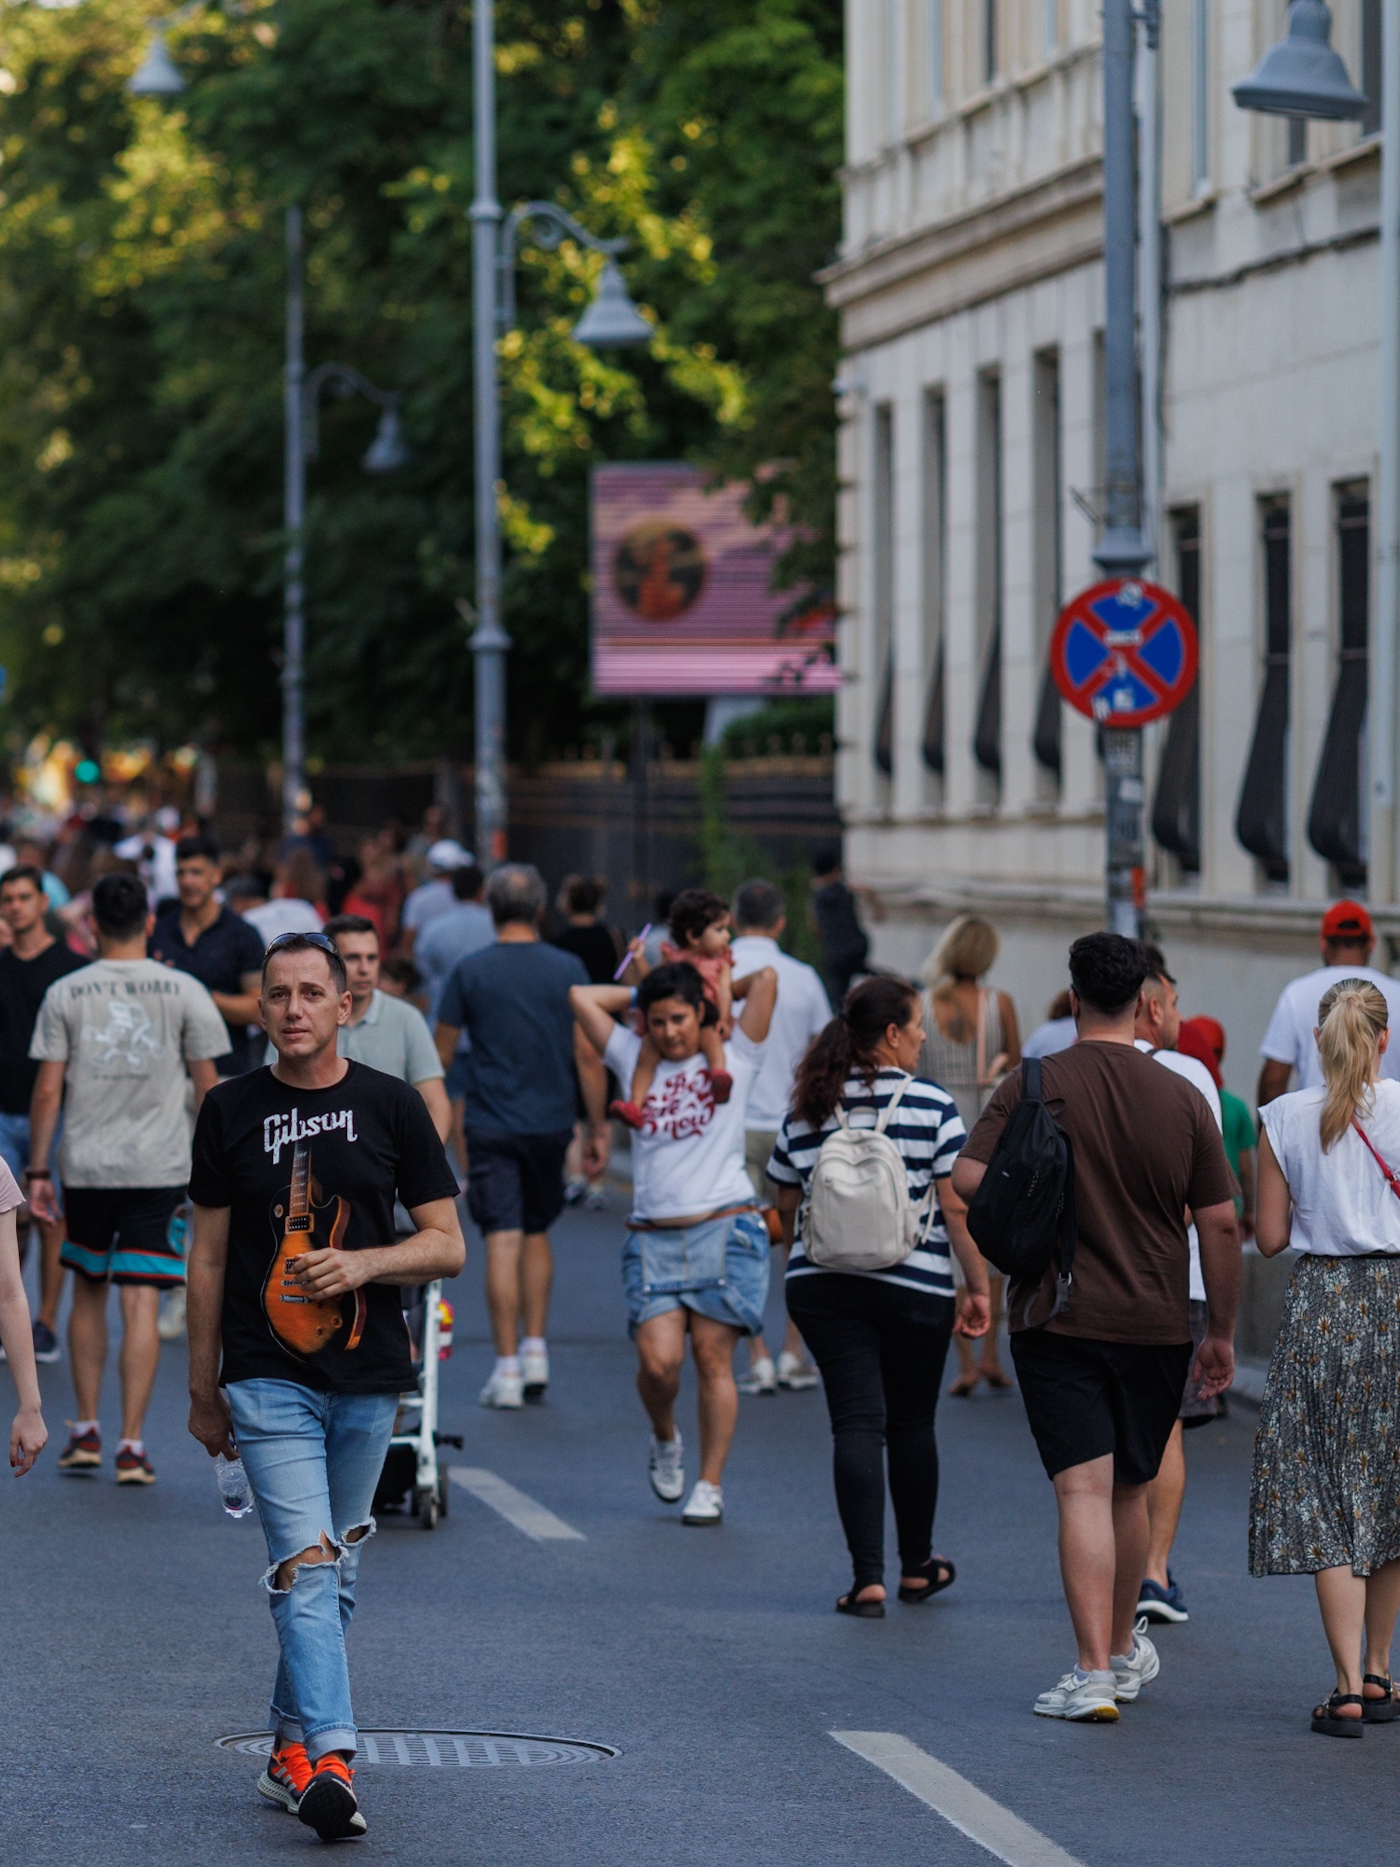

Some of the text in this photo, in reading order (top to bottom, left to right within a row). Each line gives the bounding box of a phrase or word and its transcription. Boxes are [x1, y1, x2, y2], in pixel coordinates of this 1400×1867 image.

[70, 980, 180, 998] DON'T WORRY
[263, 1107, 358, 1165] Gibson
